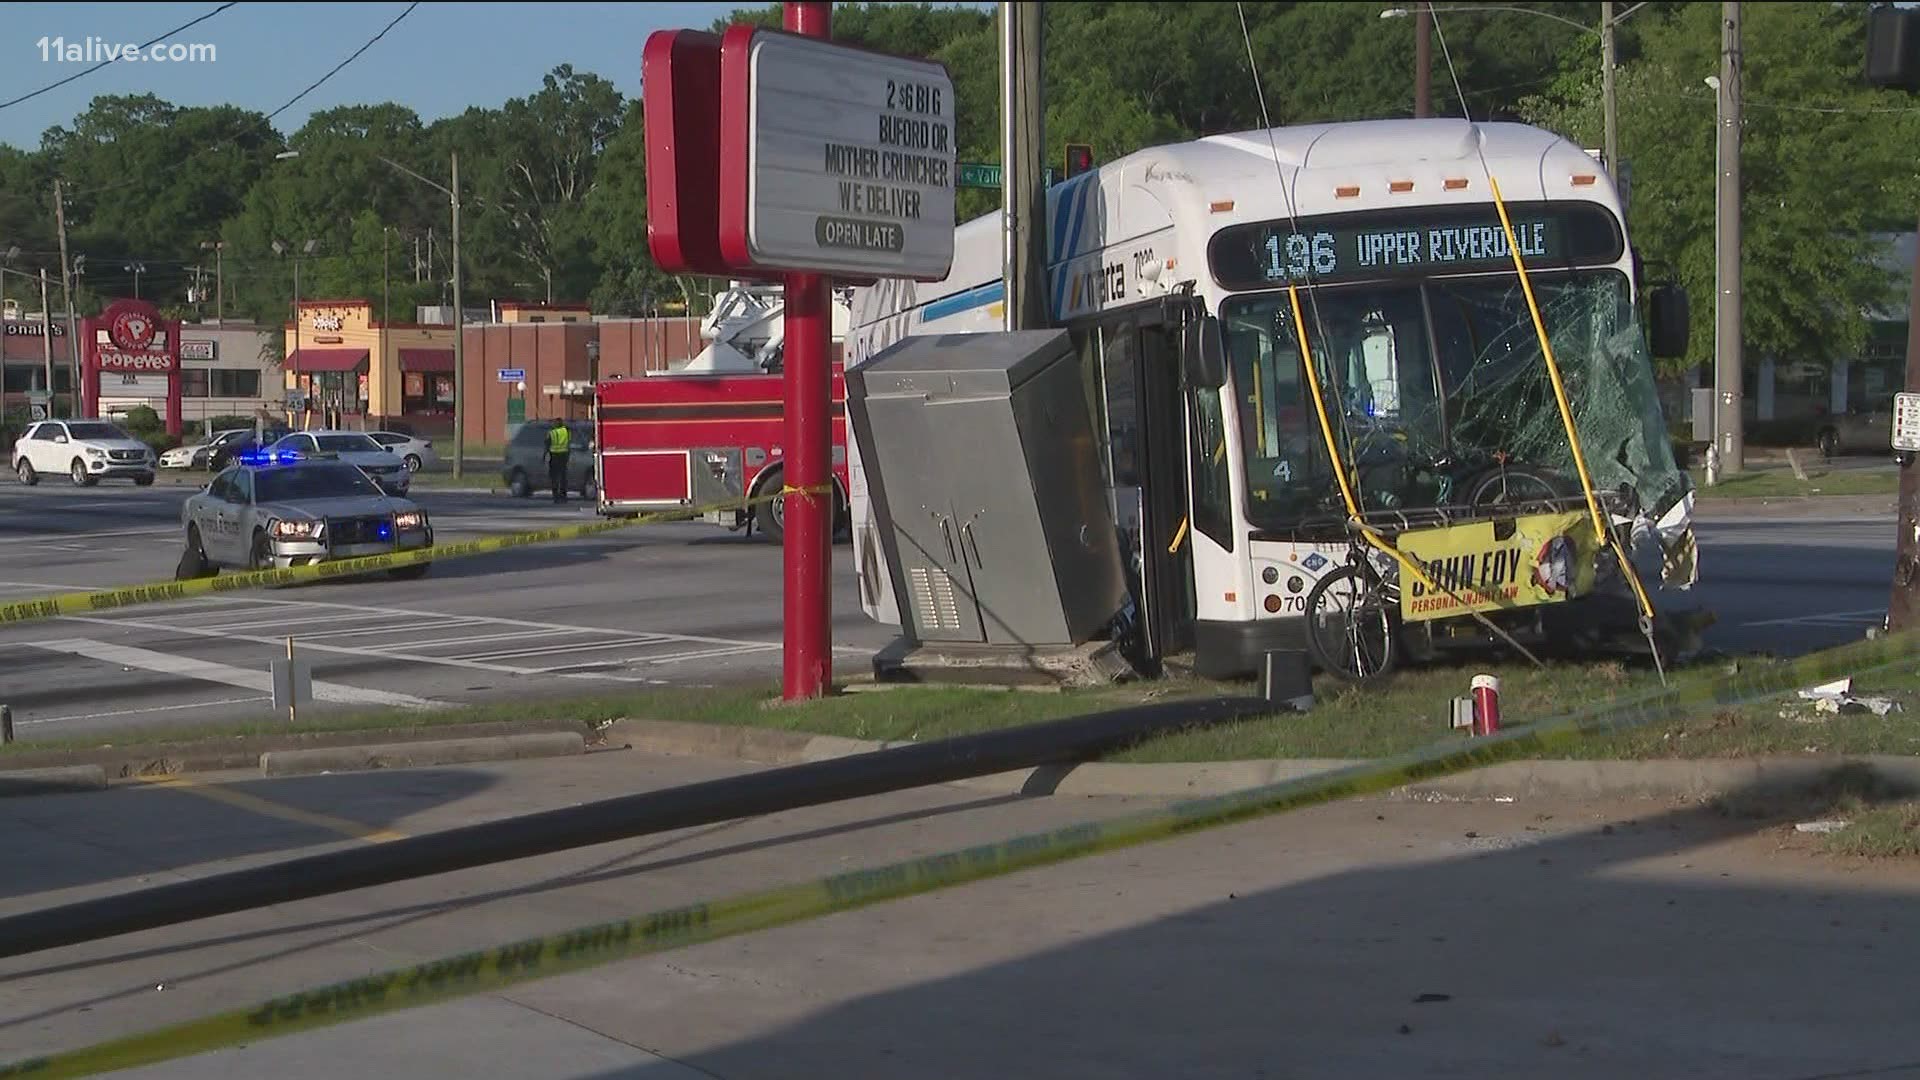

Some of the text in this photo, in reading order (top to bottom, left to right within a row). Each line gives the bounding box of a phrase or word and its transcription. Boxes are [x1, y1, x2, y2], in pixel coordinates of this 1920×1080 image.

[887, 80, 896, 110] 2
[879, 115, 948, 152] BUFORD OR
[825, 144, 949, 188] MOTHER CRUNCHER
[839, 181, 921, 219] WE DELIVER
[825, 222, 896, 248] OPEN LATE
[1264, 232, 1337, 279] 196
[1357, 232, 1422, 266] UPPER
[1481, 548, 1521, 587] FOY
[1284, 595, 1327, 612] 709
